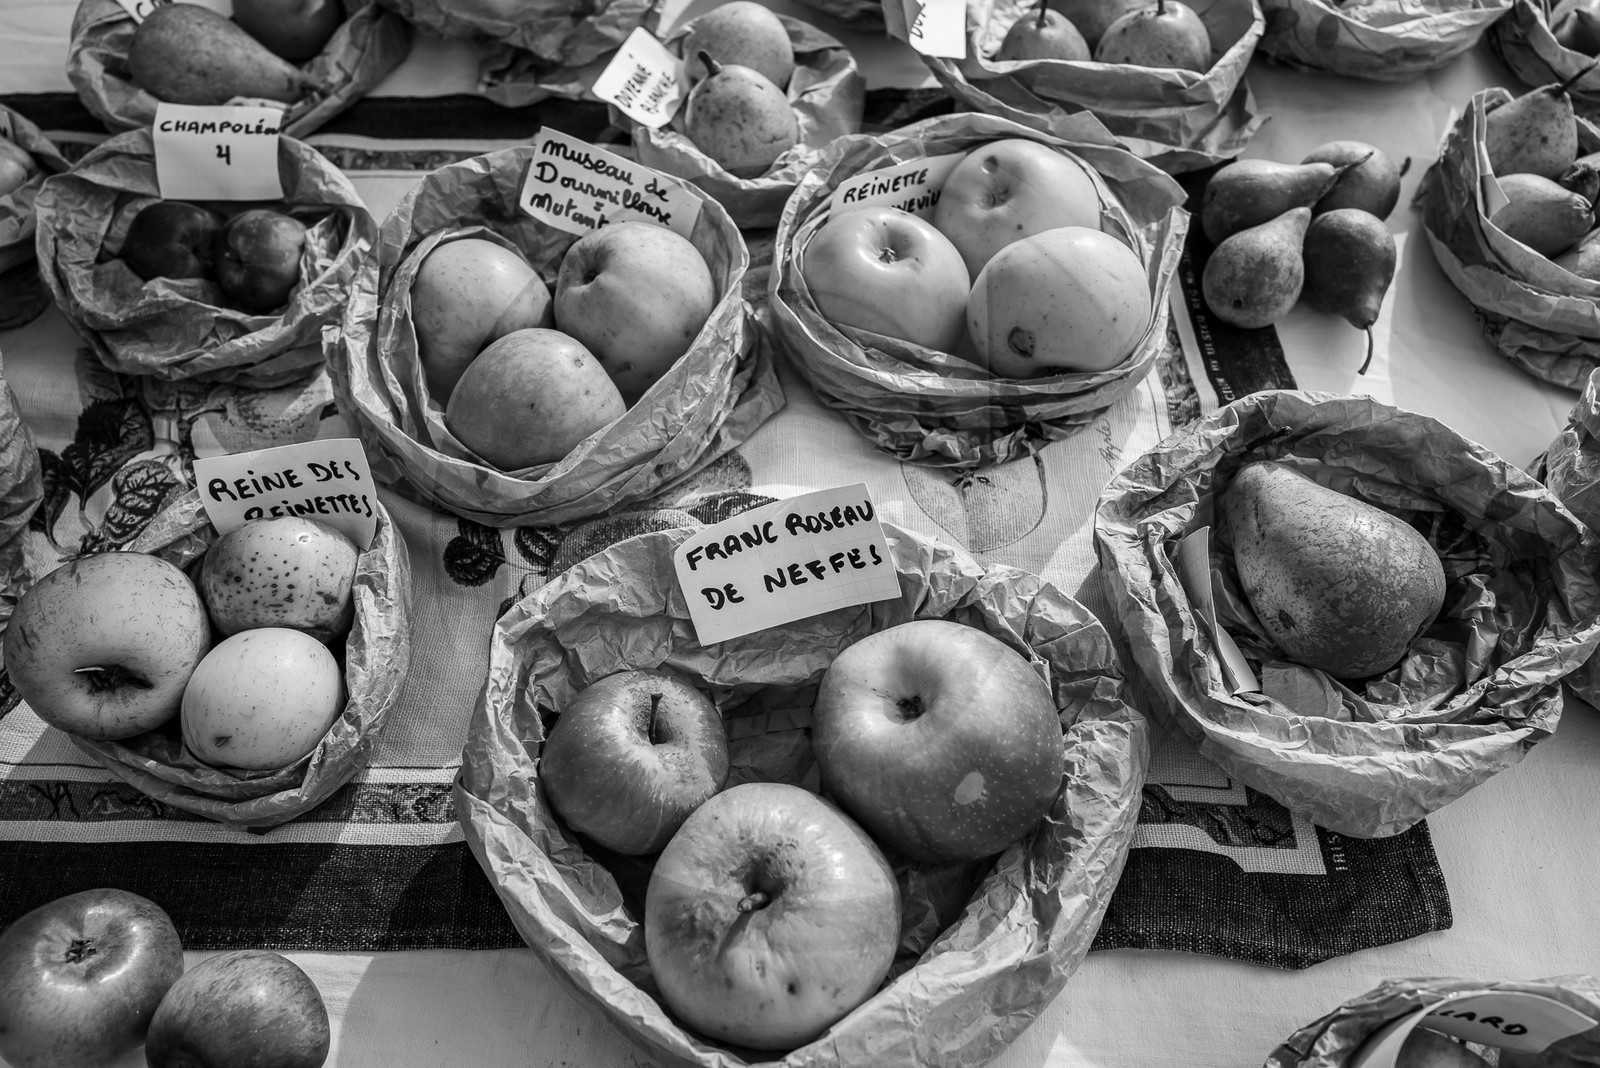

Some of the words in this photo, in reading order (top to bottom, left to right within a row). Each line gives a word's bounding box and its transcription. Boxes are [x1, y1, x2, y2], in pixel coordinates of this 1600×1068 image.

[216, 144, 231, 166] 4
[644, 177, 669, 202] de
[307, 460, 360, 481] DES
[686, 521, 779, 571] FRANC
[785, 500, 874, 536] ROSEAU
[701, 583, 745, 610] DE
